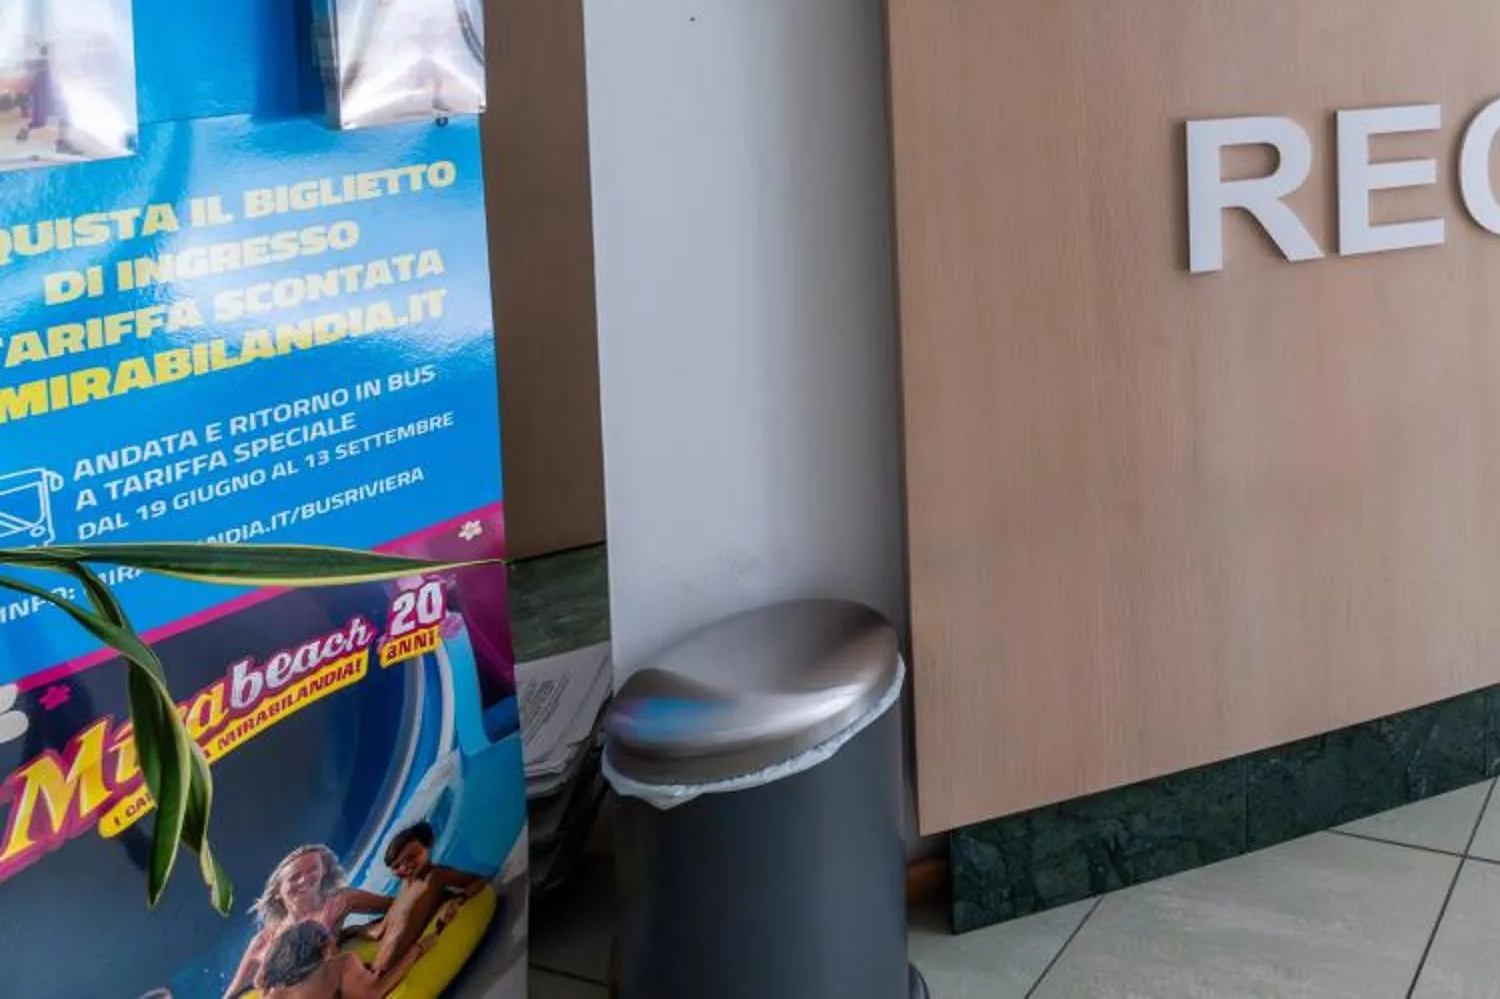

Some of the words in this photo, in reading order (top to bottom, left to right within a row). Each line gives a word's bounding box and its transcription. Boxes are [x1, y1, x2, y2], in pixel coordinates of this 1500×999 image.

[191, 196, 233, 227] IL
[244, 159, 457, 219] BIGLIETTO
[0, 298, 205, 368] ARIFFA
[213, 249, 445, 322] SCONTATA
[44, 265, 104, 306] DI
[117, 220, 360, 291] INGRESSO
[0, 288, 447, 425] MIRABILANDIA.IT
[73, 423, 198, 482] ANDATA
[205, 421, 223, 443] E
[229, 388, 350, 436] RITORNO
[355, 378, 381, 404] IN
[388, 364, 437, 392] BUS
[76, 489, 98, 511] A
[103, 450, 229, 501] TARIFFA
[234, 412, 357, 464] SPECIALE
[78, 512, 129, 541] DAL
[135, 500, 168, 523] 19
[173, 469, 267, 512] GIUGNO
[270, 459, 299, 481] AL
[304, 448, 331, 469] 13
[335, 410, 456, 461] SETTEMBRE
[390, 581, 443, 636] 20
[217, 658, 362, 748] MIRABILANDIA!
